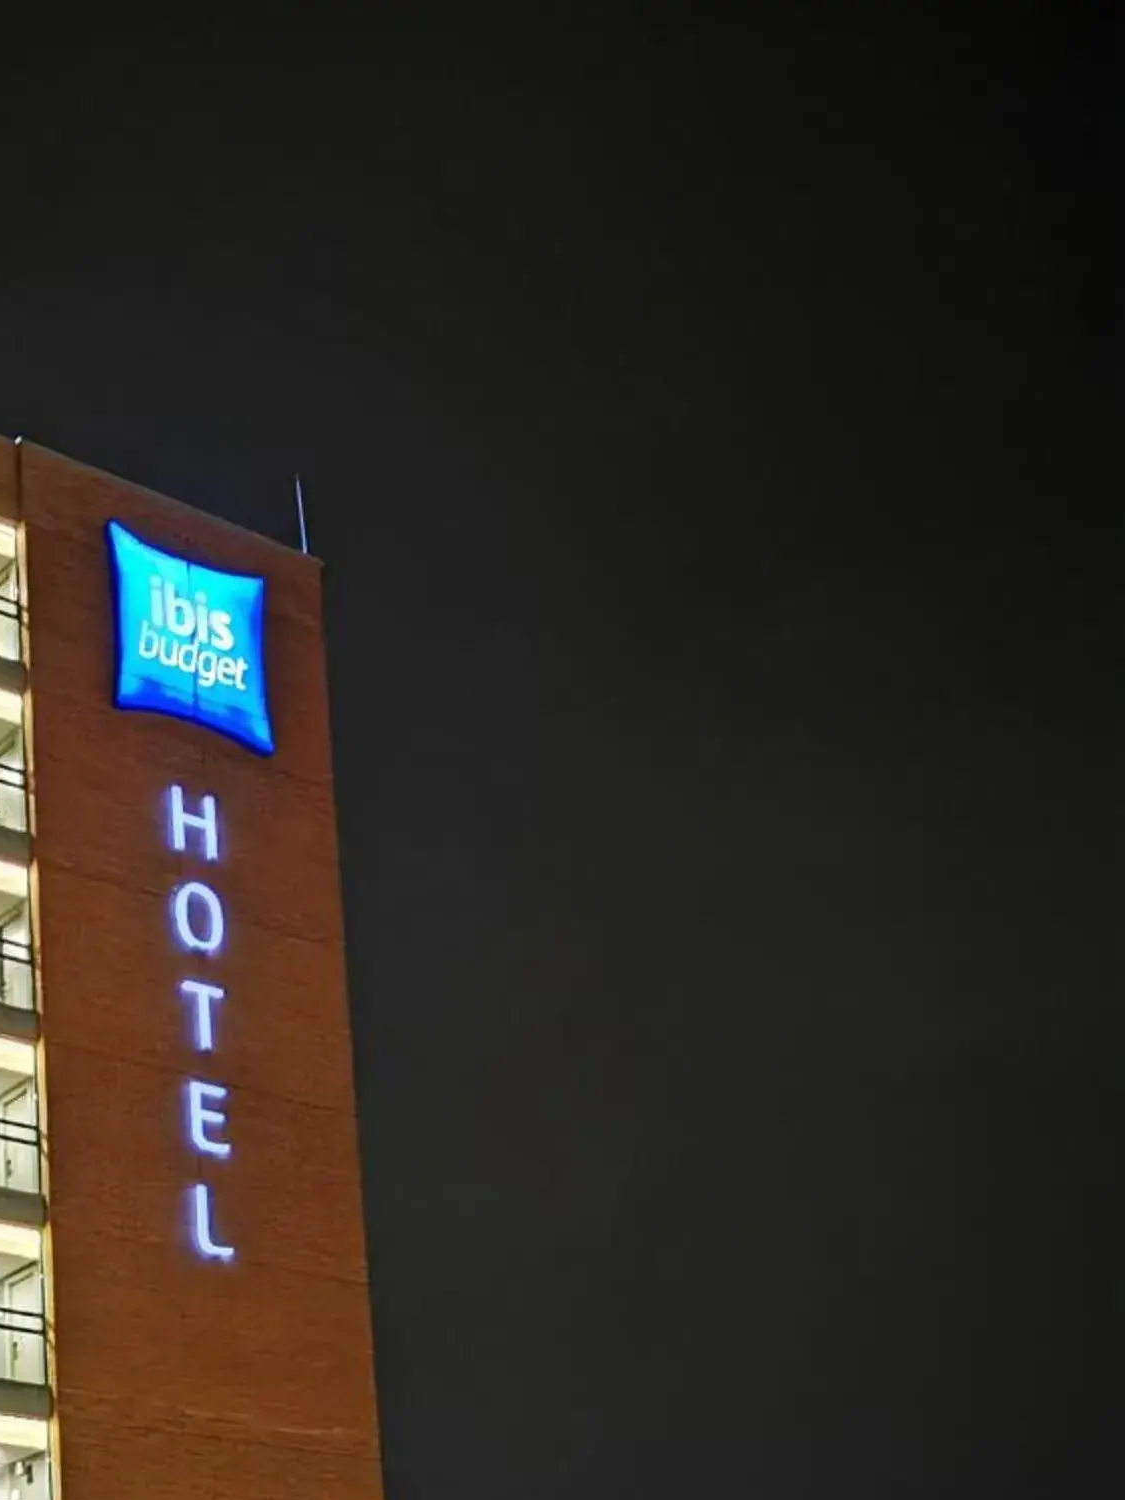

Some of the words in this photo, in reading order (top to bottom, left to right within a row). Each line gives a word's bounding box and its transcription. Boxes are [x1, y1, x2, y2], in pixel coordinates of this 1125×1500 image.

[150, 575, 235, 651] ibis
[138, 620, 248, 691] budget
[170, 784, 234, 1259] HOTEL
